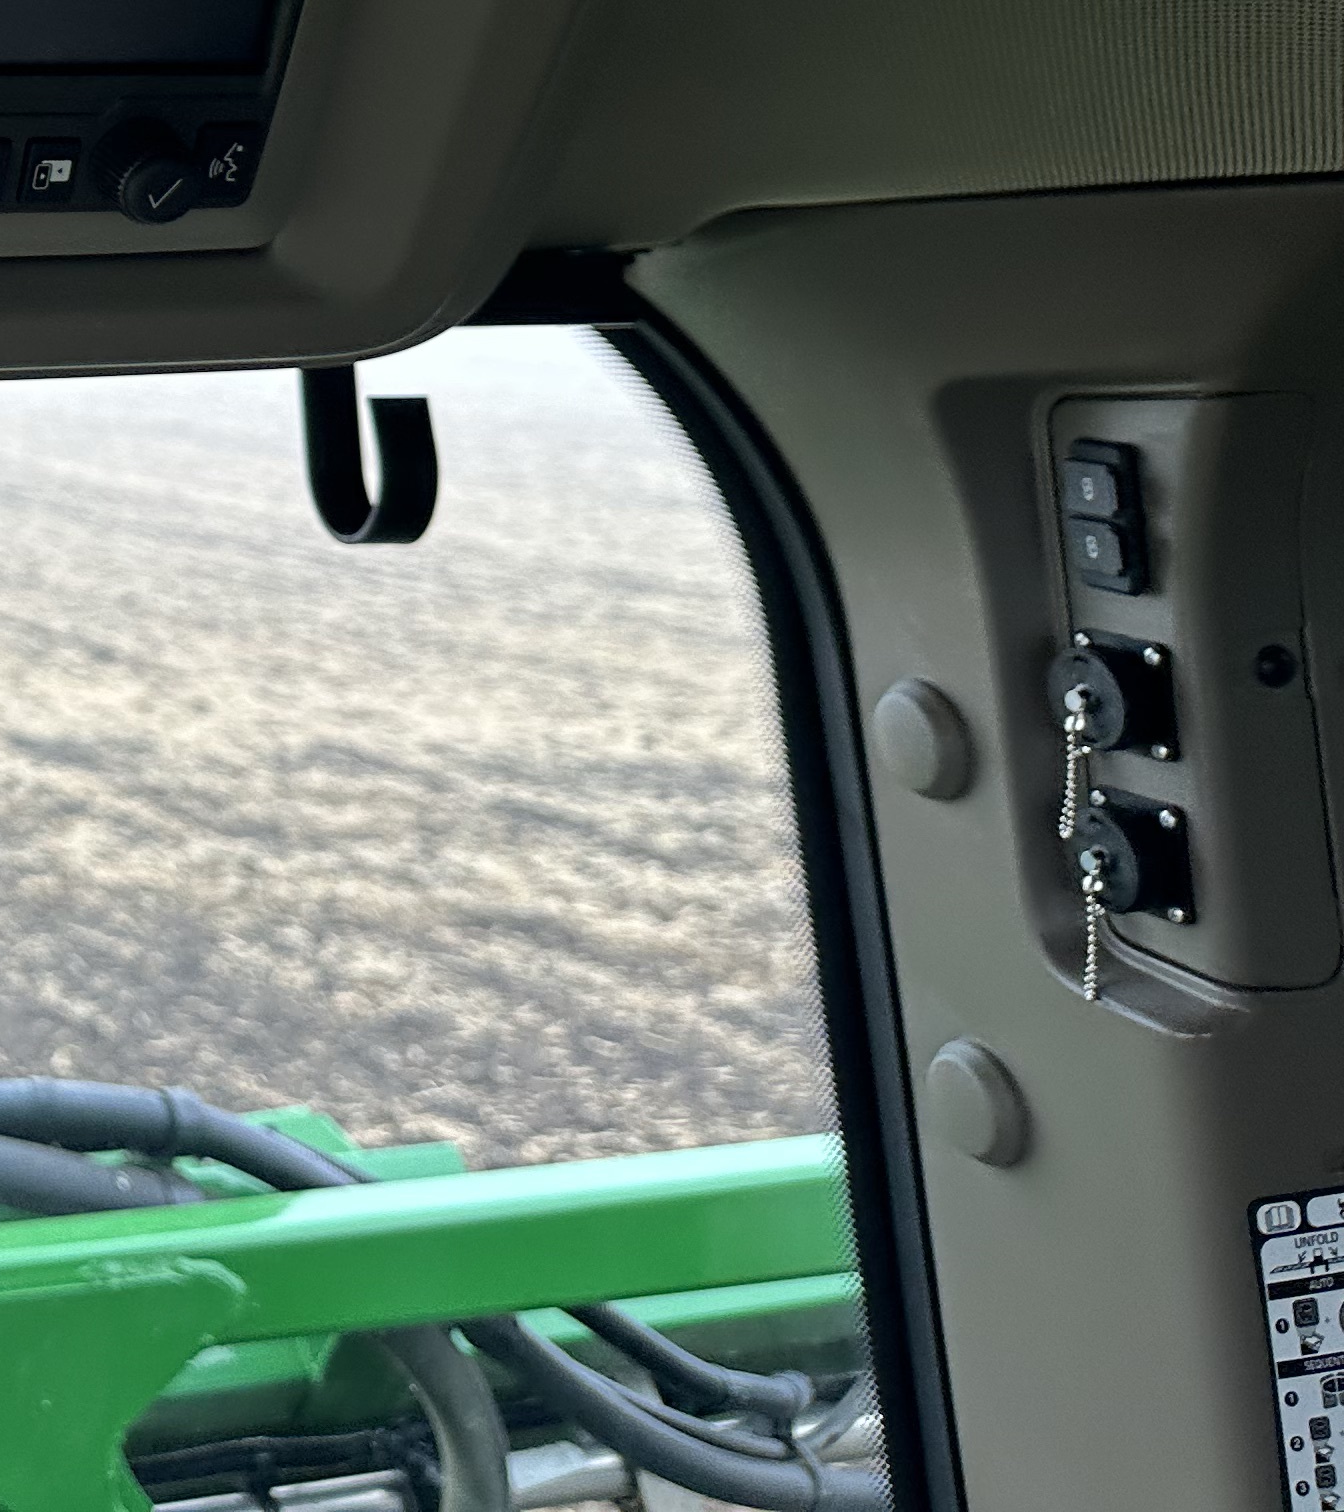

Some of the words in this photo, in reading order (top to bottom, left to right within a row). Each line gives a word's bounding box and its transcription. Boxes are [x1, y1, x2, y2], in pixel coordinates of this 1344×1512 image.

[1294, 1231, 1339, 1249] UNFOLD
[1279, 1320, 1285, 1331] 1
[1288, 1393, 1295, 1404] 1
[1293, 1437, 1301, 1449] 2
[1299, 1482, 1308, 1494] 3
